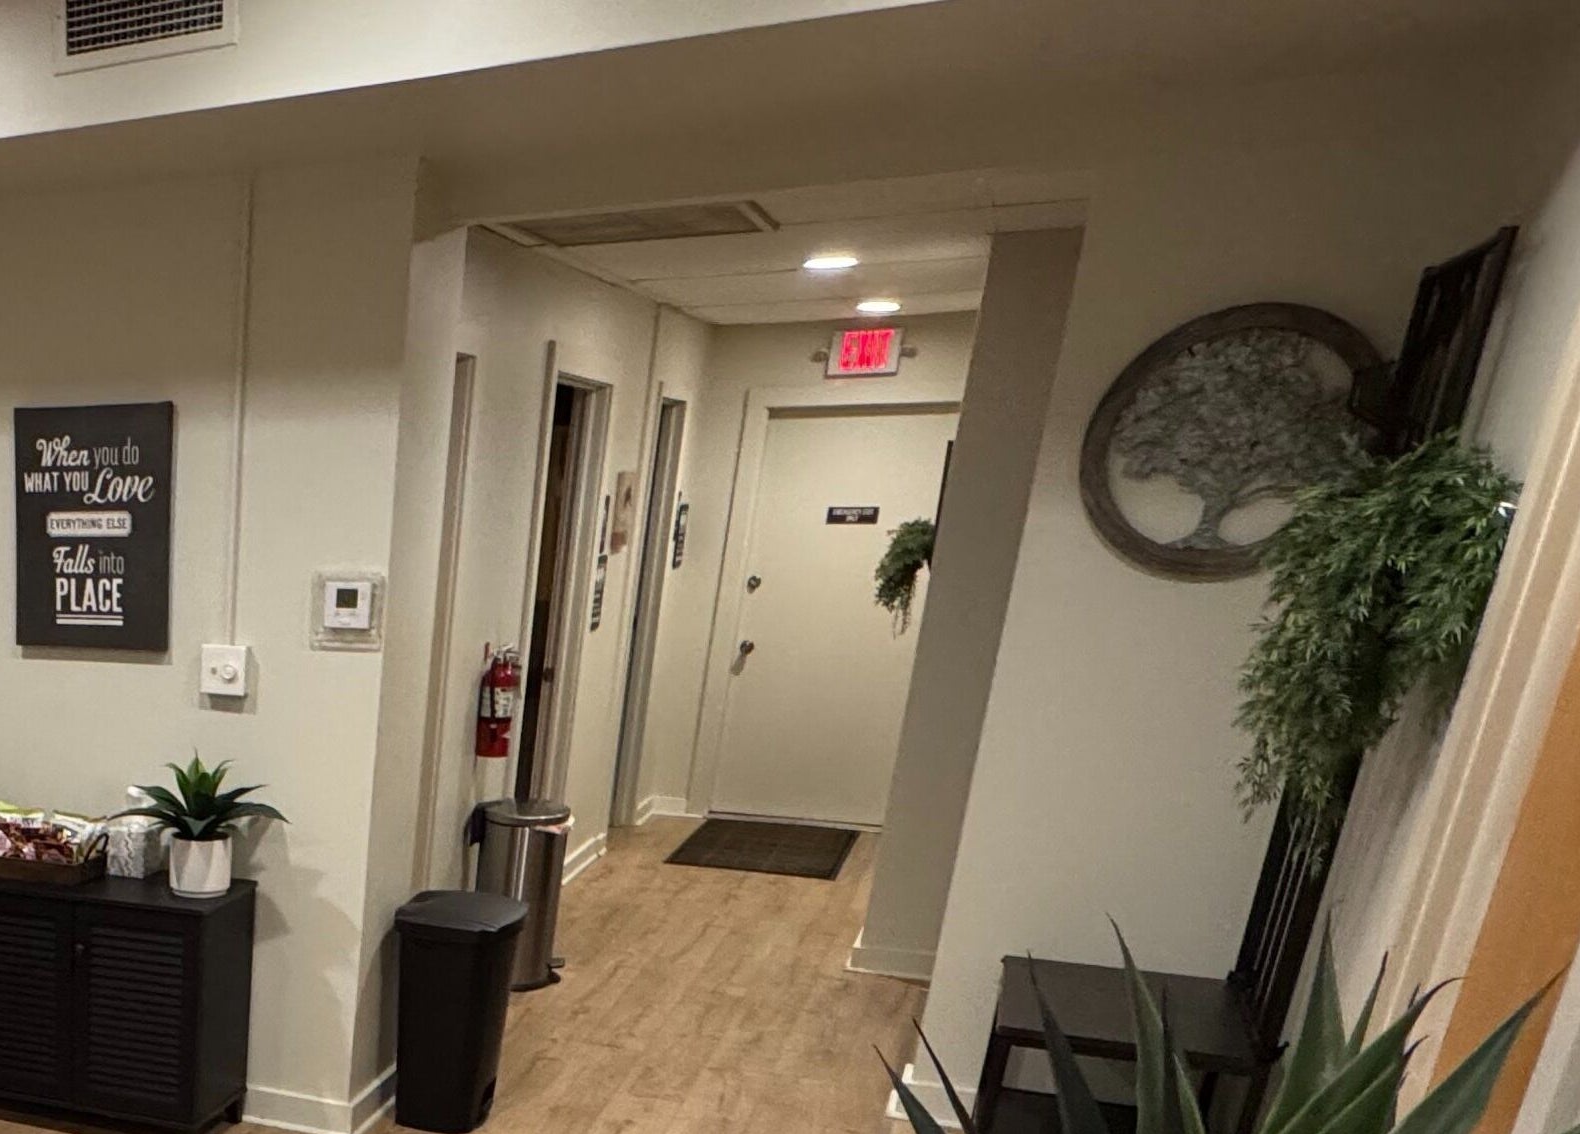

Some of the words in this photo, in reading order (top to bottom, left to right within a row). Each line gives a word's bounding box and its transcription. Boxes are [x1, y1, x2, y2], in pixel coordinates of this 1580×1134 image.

[840, 328, 895, 370] EXIT
[36, 435, 91, 467] When
[93, 446, 119, 470] you
[122, 437, 139, 466] do
[24, 472, 60, 494] WHAT
[63, 471, 89, 492] YOU
[83, 467, 155, 504] Love
[50, 518, 103, 531] EVERYTHING
[106, 517, 128, 530] ELSE
[52, 544, 96, 575] Falls
[99, 551, 124, 575] into
[55, 578, 124, 612] PLACE
